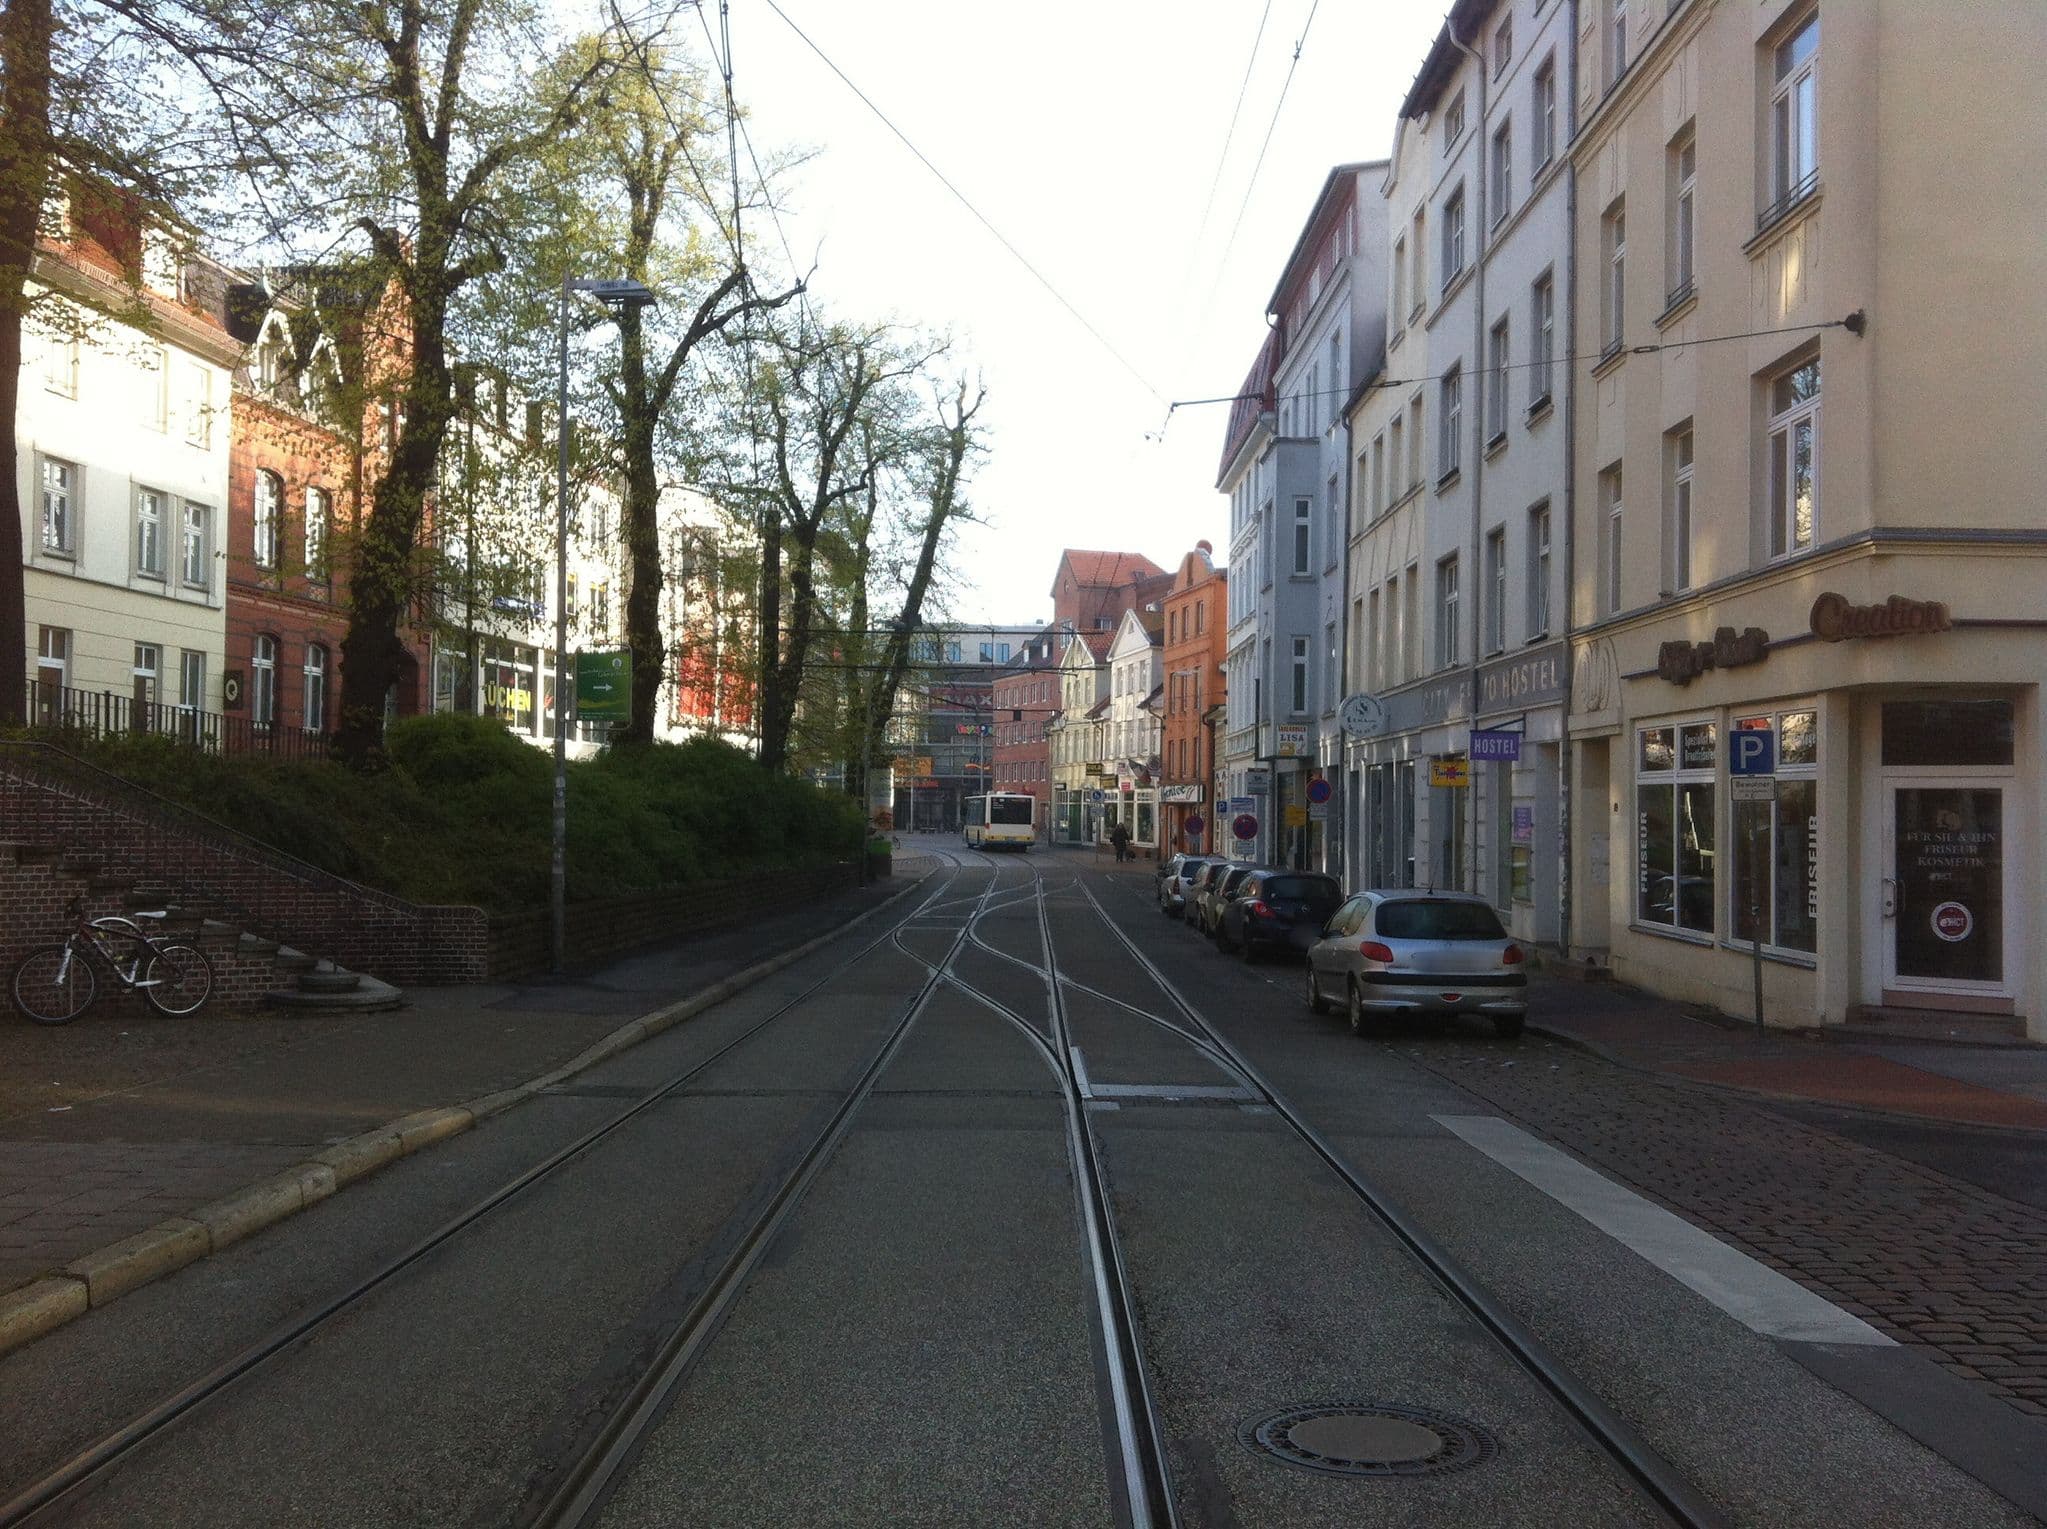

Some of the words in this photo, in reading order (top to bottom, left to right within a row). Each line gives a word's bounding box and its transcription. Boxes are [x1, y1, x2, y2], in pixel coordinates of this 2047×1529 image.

[1811, 592, 1952, 642] Creation
[1502, 657, 1559, 699] HOSTEL
[1280, 733, 1304, 742] LISA
[1474, 739, 1516, 754] HOSTEL
[1740, 736, 1764, 769] P
[1640, 810, 1649, 894] FRISEUR
[1917, 857, 1985, 866] KOSMETIK
[1924, 844, 1978, 854] FRISEUR
[1808, 815, 1818, 919] FRISEUR
